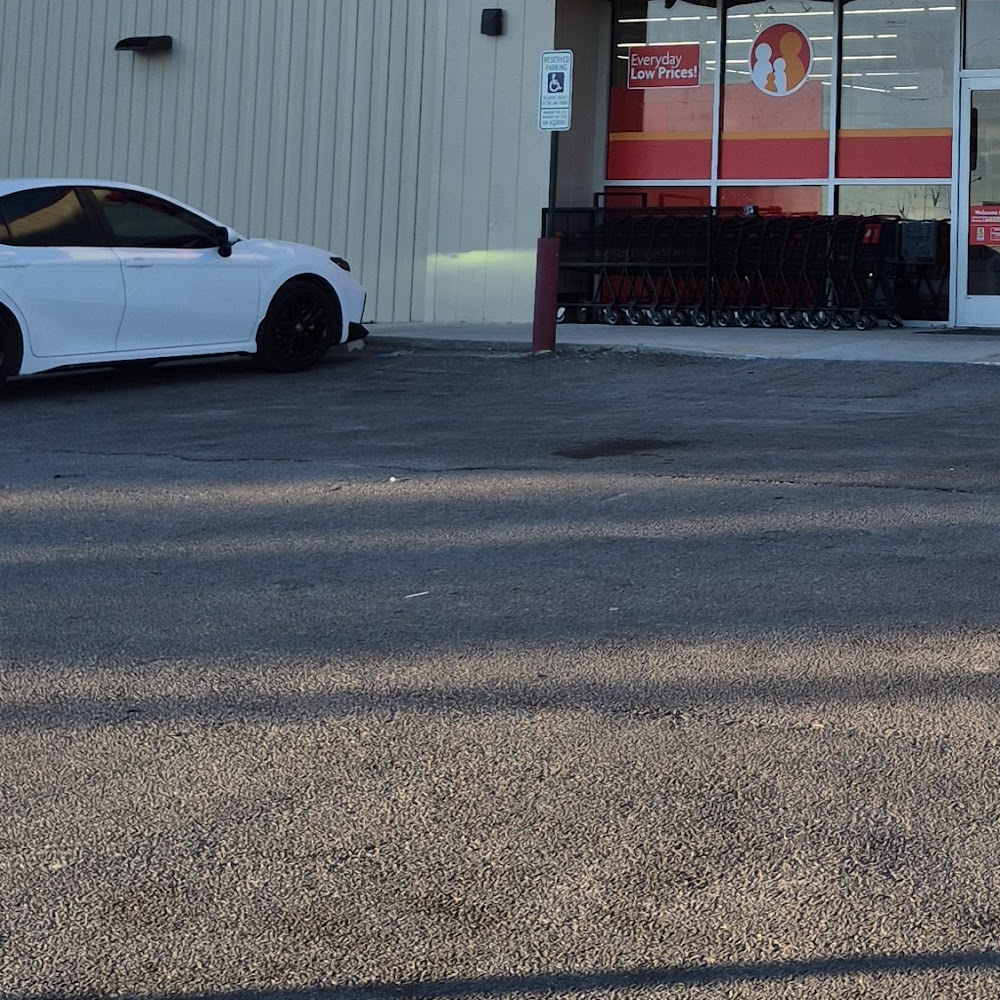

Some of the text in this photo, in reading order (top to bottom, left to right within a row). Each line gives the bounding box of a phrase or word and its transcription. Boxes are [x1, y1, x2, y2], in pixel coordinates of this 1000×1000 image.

[544, 55, 569, 63] RESERVED
[630, 51, 682, 68] Everyday
[546, 63, 568, 71] PARKING
[630, 65, 698, 80] Low Prices!
